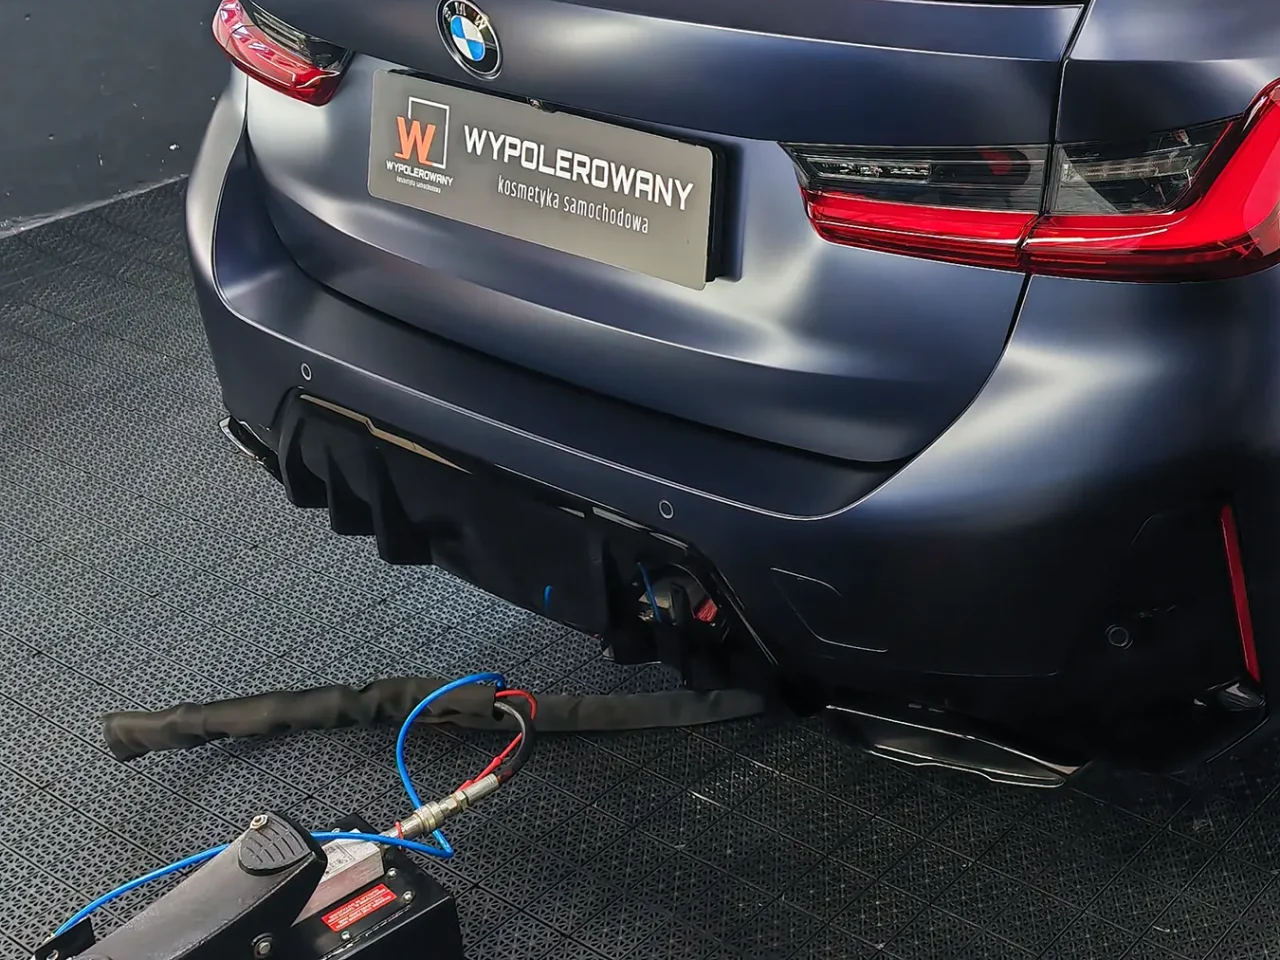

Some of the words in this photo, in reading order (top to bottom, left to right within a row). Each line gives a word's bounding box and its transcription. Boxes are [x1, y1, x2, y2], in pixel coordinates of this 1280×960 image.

[385, 159, 454, 187] WYPOLEROWANY
[463, 124, 694, 211] WYPOLEROWANY
[497, 175, 560, 210] kosmetyka
[563, 195, 649, 234] samochodowa
